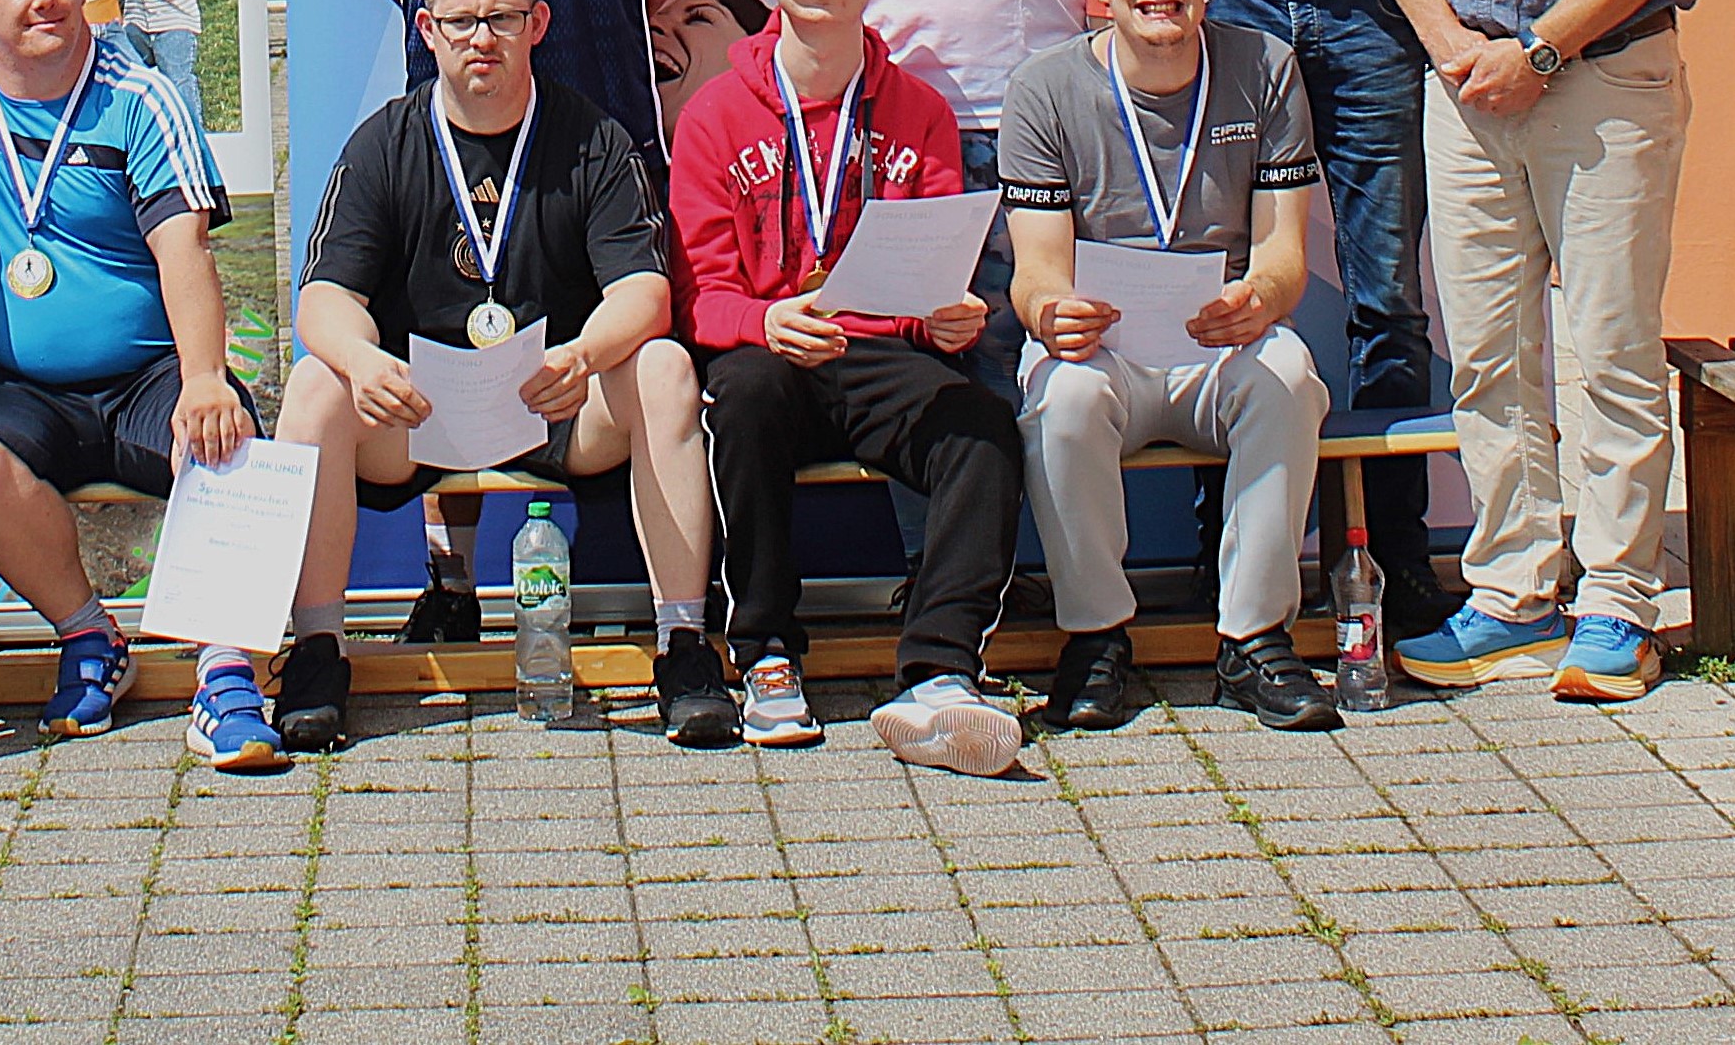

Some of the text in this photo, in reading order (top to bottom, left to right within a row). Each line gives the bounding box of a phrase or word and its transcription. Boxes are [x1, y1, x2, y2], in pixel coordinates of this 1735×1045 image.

[1211, 122, 1256, 138] CIPTR
[1260, 165, 1304, 183] CHAPTER
[1007, 184, 1051, 204] CHAPTER
[250, 459, 305, 476] URKUNDE
[518, 578, 565, 595] Volvic
